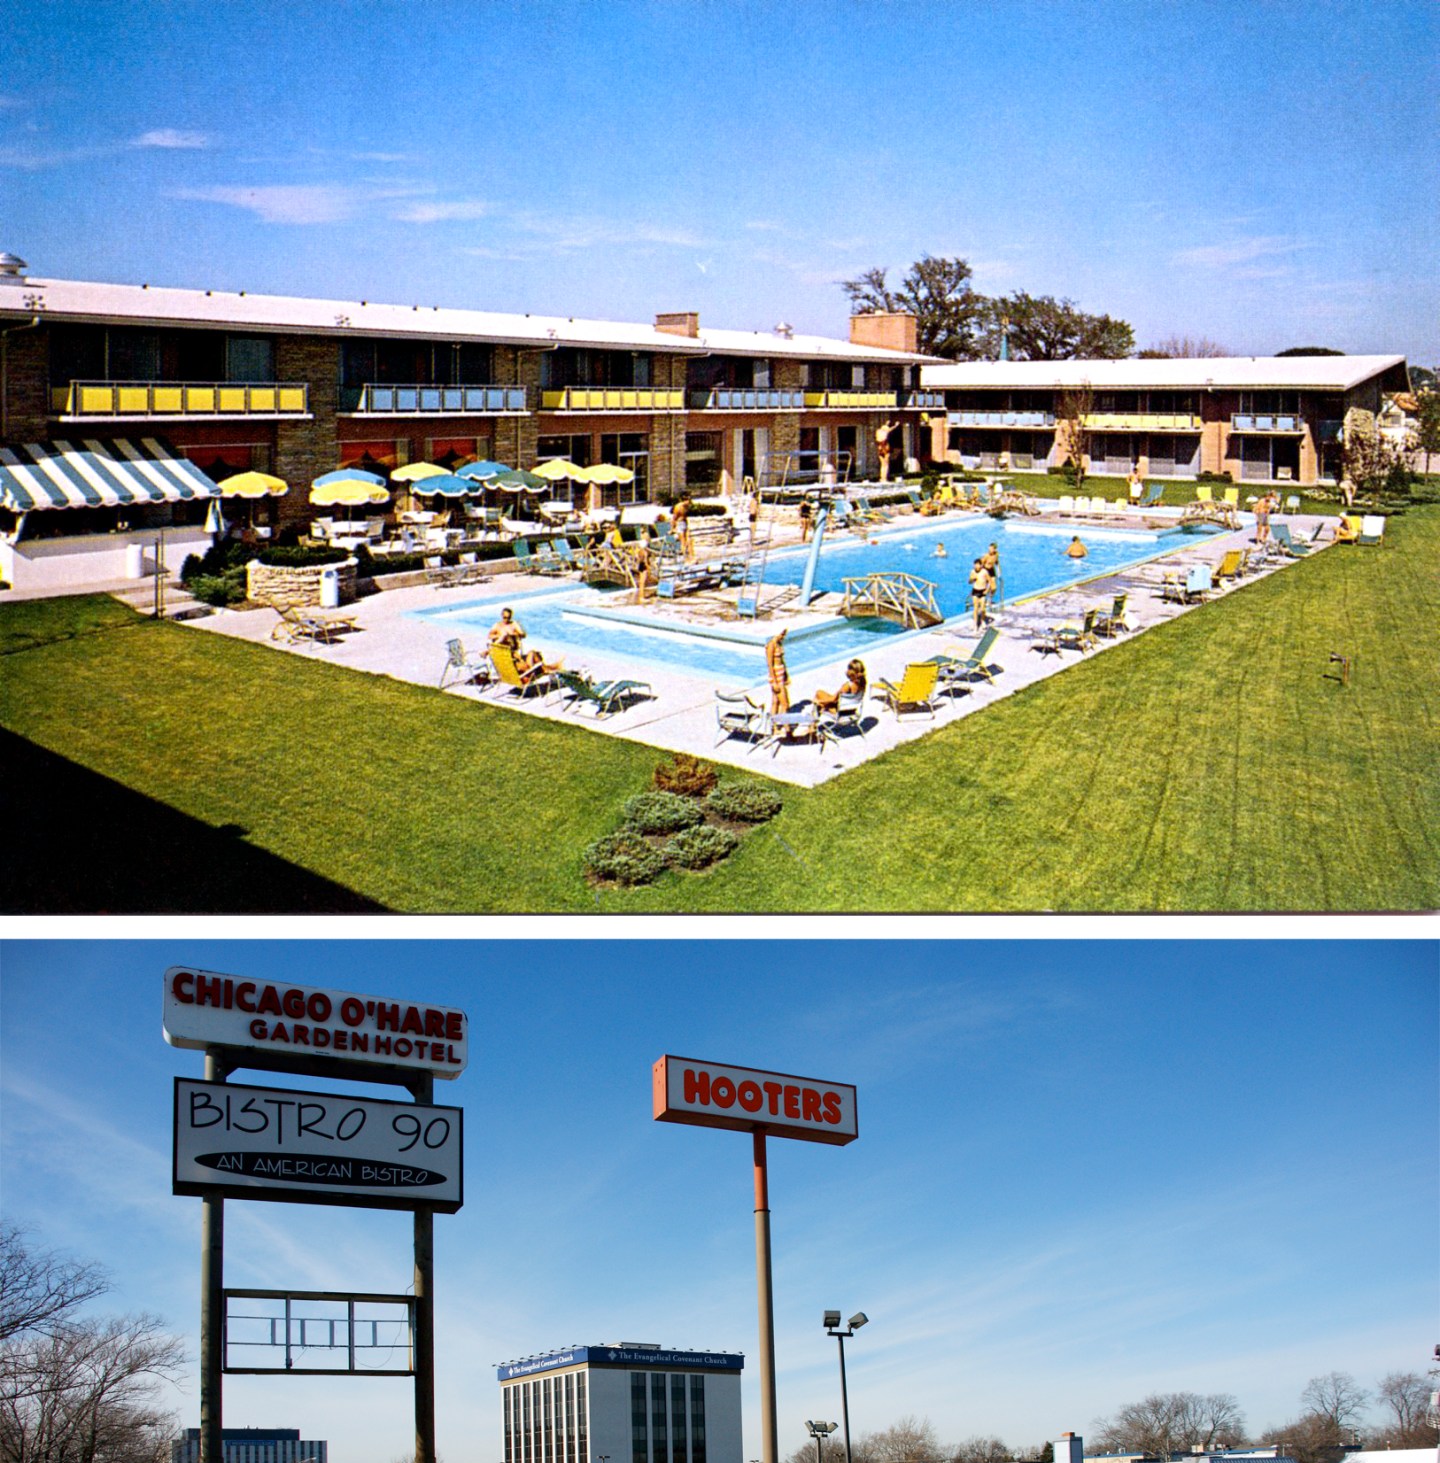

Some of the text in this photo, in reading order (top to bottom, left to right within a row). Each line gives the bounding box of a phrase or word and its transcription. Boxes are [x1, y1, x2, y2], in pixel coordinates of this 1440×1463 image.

[173, 972, 463, 1041] CHICAGO O'HARE
[190, 1091, 451, 1152] BISTRO 90
[684, 1069, 842, 1125] HOOTERS
[217, 1153, 428, 1185] AN AMERICAN BISTRO
[619, 1351, 728, 1364] The Evangelical Covenant Church
